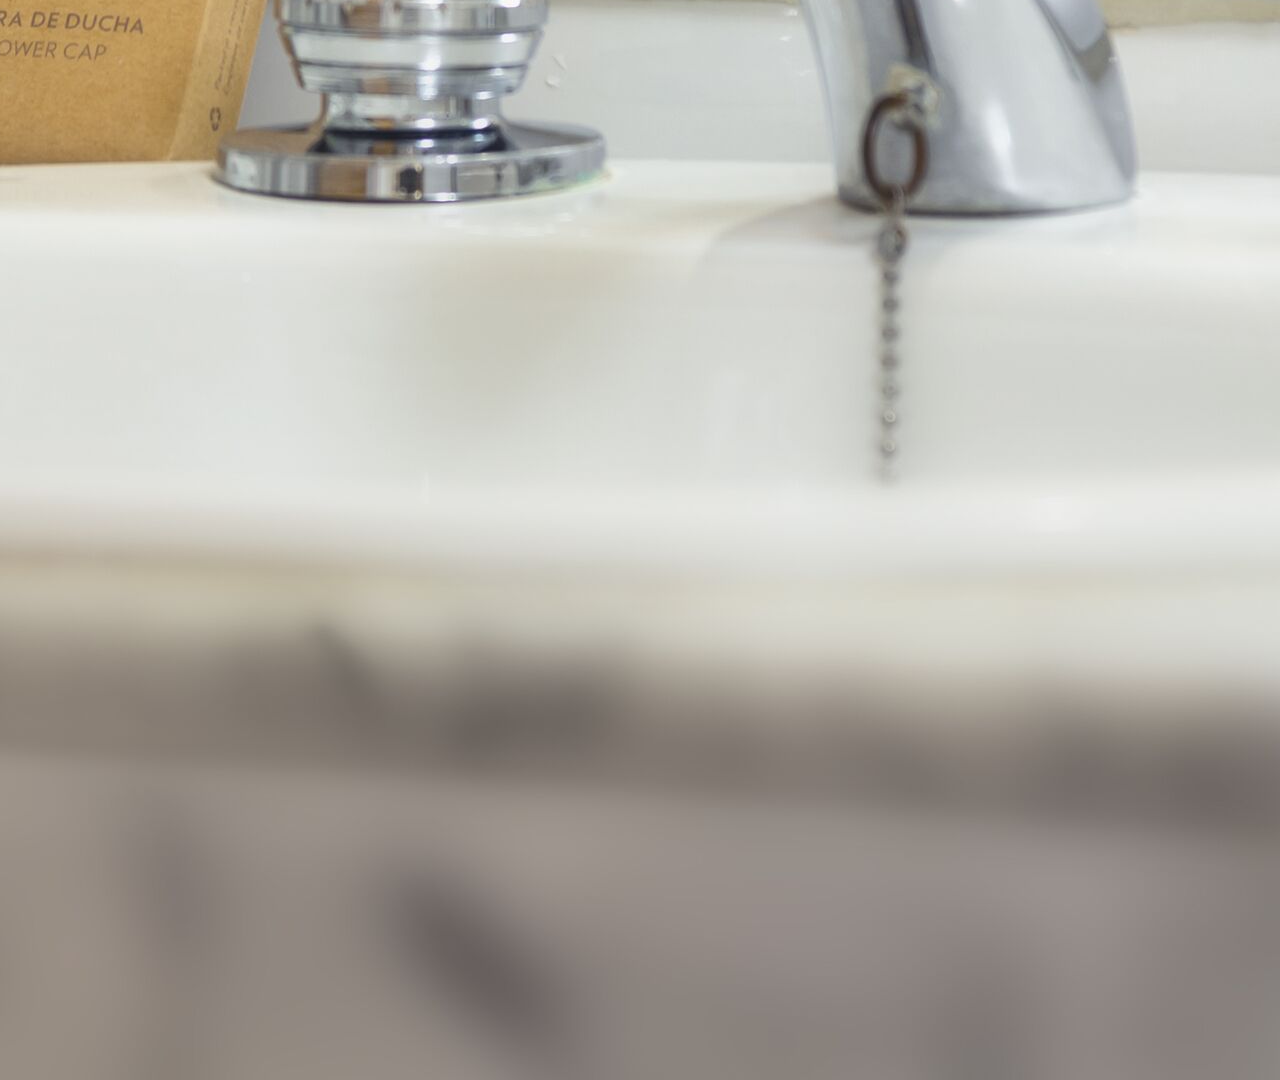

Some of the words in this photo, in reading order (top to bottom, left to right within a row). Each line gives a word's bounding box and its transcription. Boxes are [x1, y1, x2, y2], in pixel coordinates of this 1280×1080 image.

[30, 11, 60, 29] DE
[64, 13, 144, 34] DUCHA
[63, 42, 108, 62] CAP
